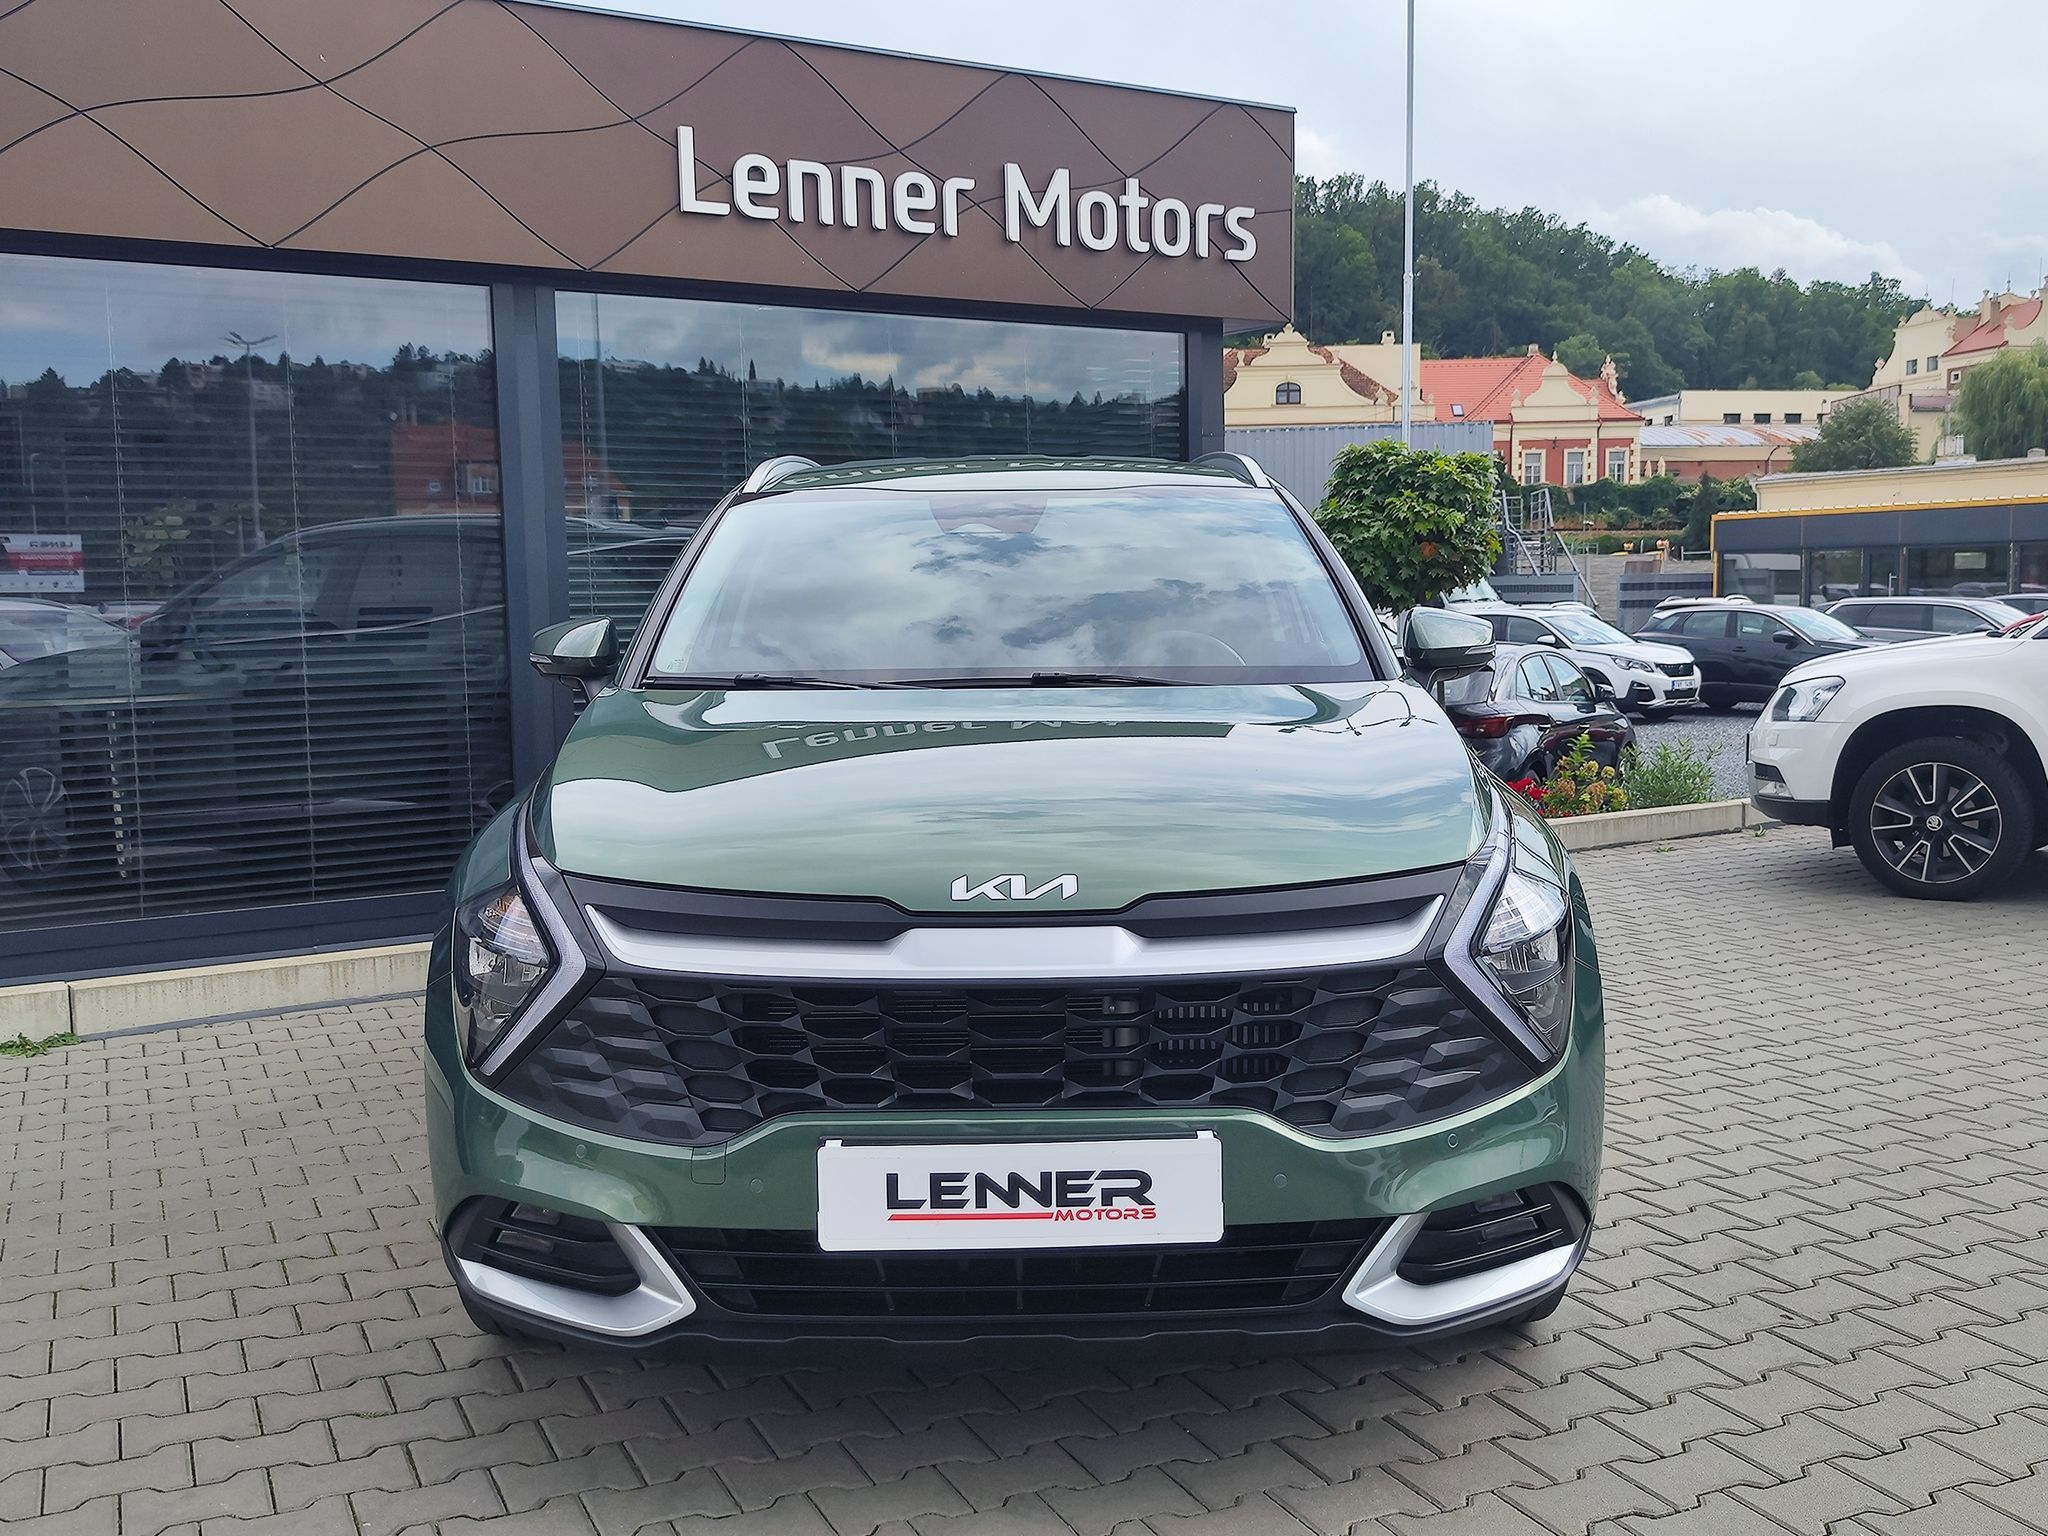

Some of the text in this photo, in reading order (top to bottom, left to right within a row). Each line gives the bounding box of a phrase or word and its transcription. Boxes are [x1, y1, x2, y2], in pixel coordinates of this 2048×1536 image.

[676, 125, 1257, 262] Lenner Motors
[950, 873, 1079, 901] KIA
[886, 1170, 1156, 1210] LENNER
[1054, 1207, 1157, 1222] MOTORS
